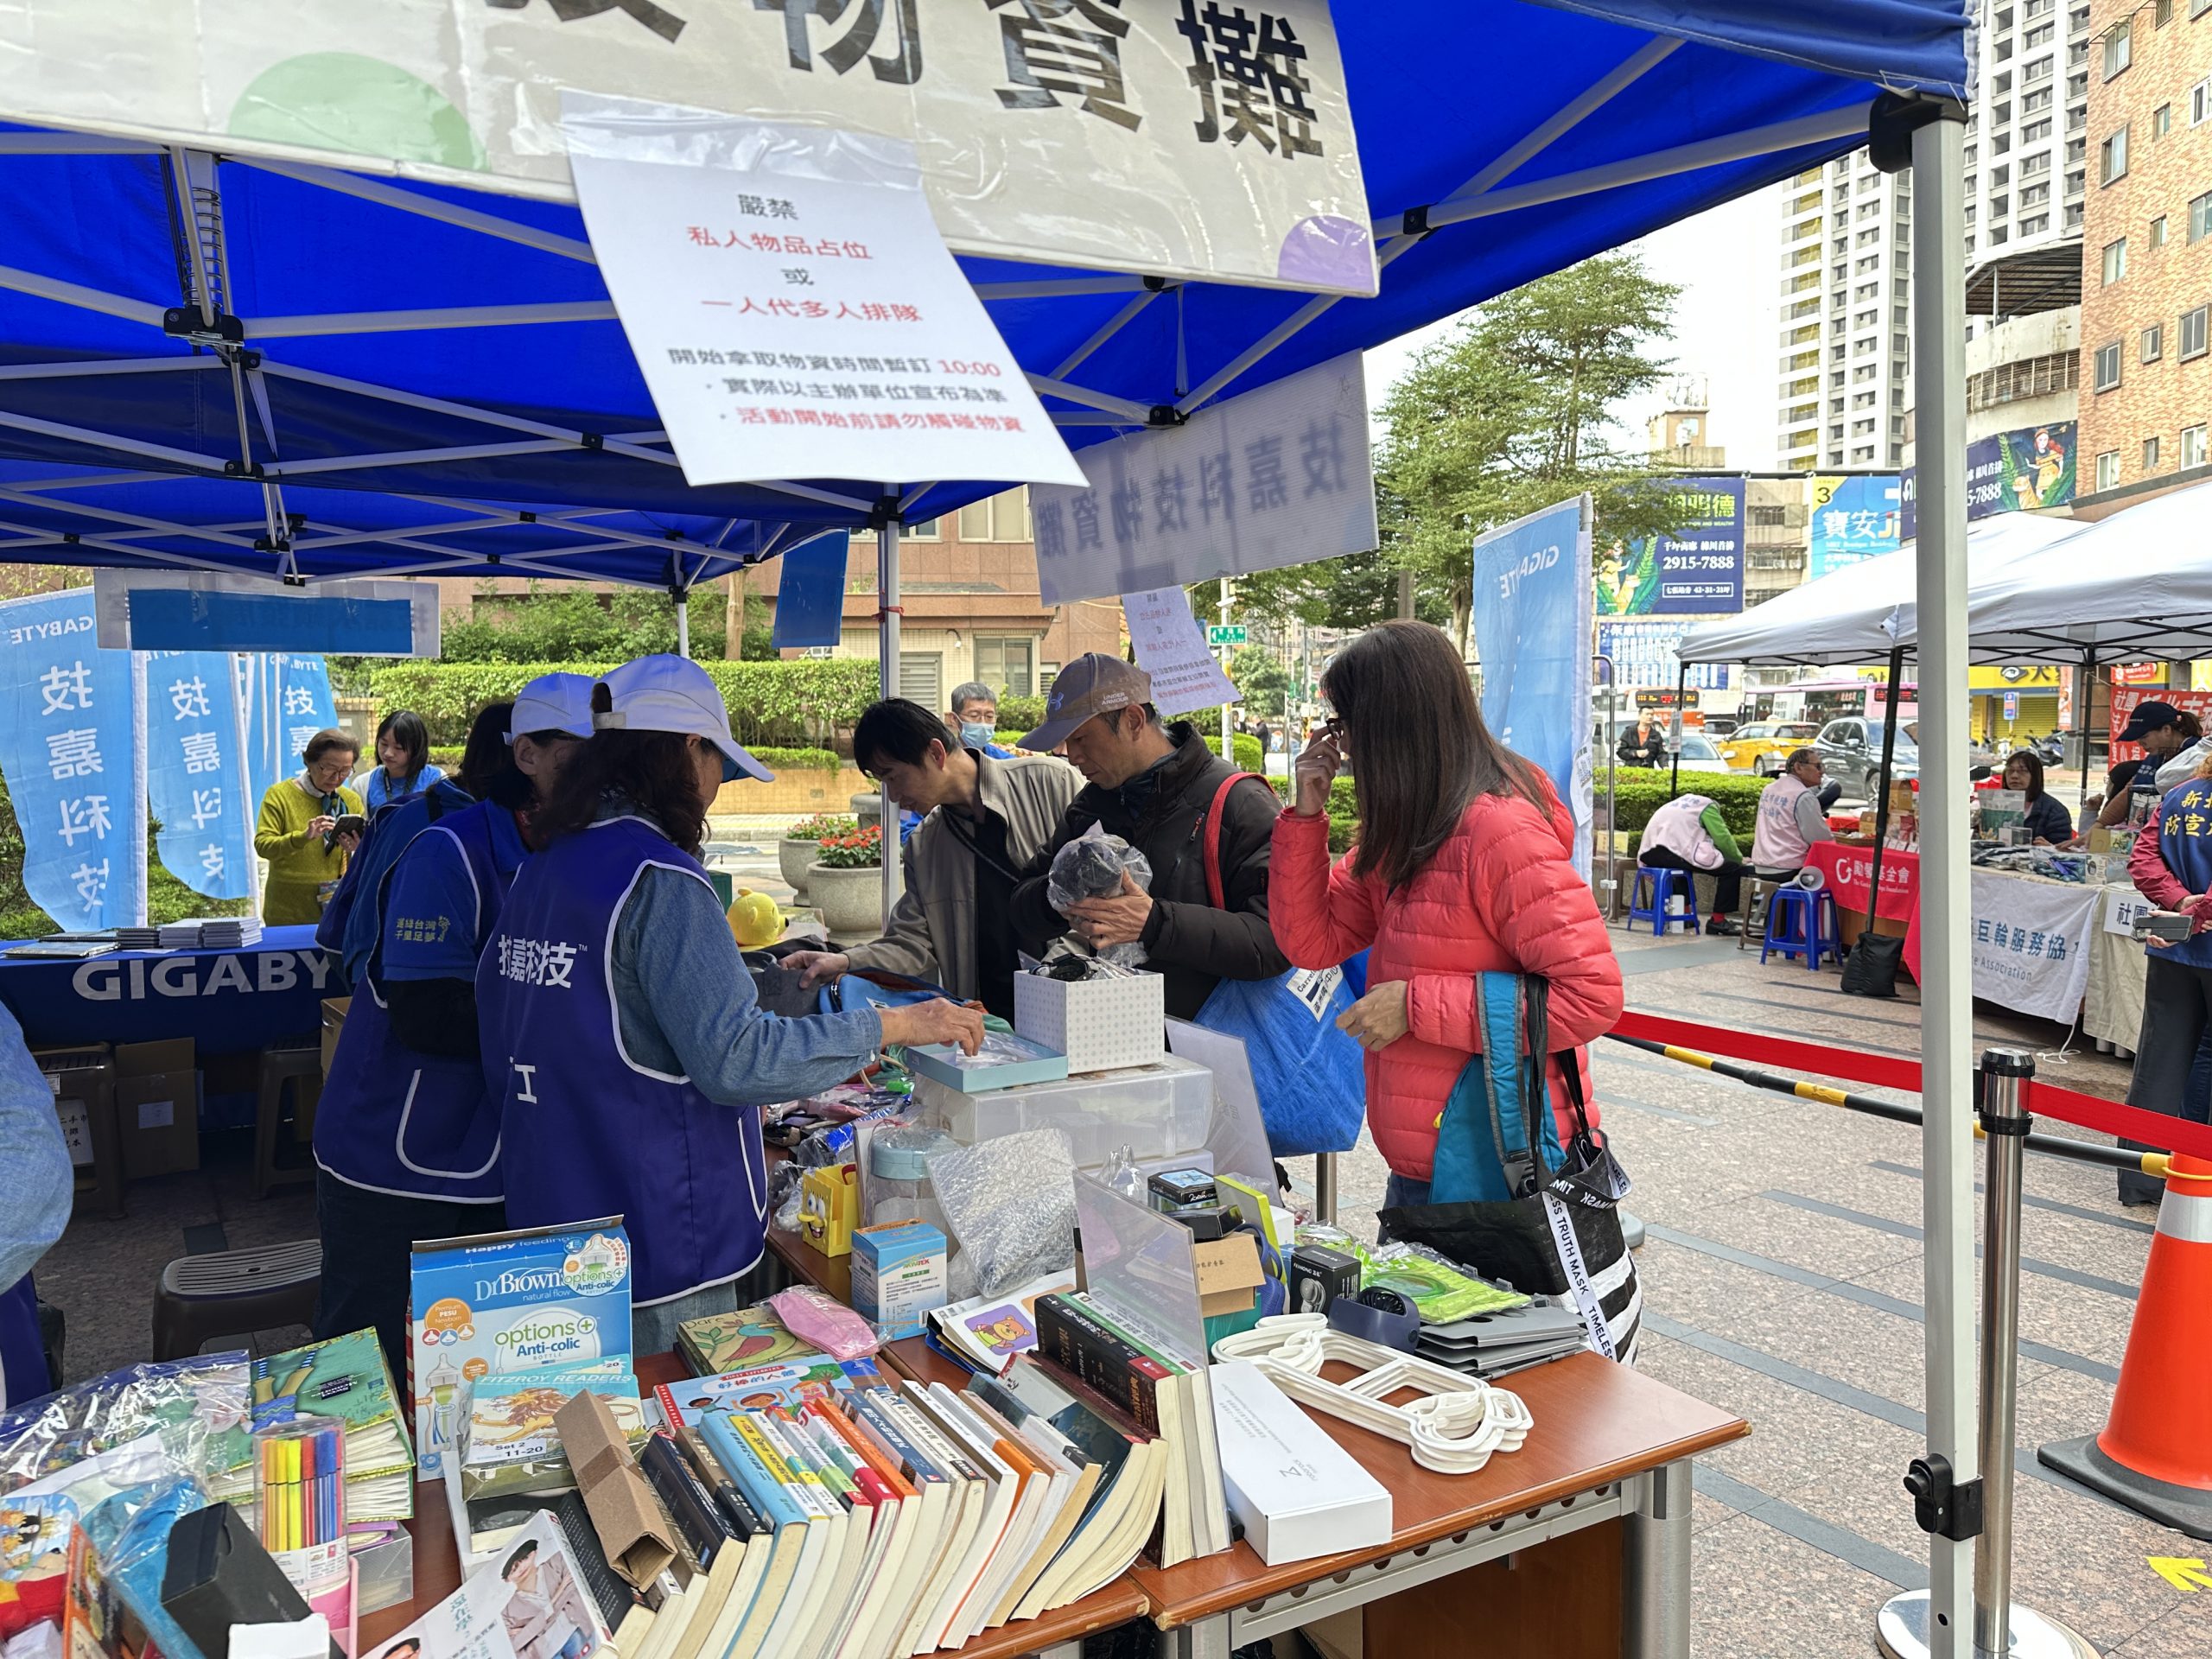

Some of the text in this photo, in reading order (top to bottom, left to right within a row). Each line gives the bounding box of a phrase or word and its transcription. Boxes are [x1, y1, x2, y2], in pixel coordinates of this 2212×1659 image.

[482, 0, 1324, 161] 物資攤
[738, 194, 799, 221] 嚴禁
[686, 226, 874, 260] 私人物品占位
[781, 268, 815, 287] 或
[701, 296, 924, 322] 一人代多人排隊
[667, 348, 1001, 378] 開始拿取物資時間暫訂 10:00
[721, 377, 1008, 404] 實際以主辦單位宣布為準
[735, 406, 1026, 434] 活動開始前請勿觸碰物資
[1816, 486, 1832, 505] 3
[1662, 555, 1735, 570] 2915-7888
[1102, 696, 1128, 705] ARMOUR
[2164, 813, 2212, 836] 防宣
[1971, 916, 2082, 962] 巨輪服務協
[73, 951, 332, 1001] GIGABY
[1980, 957, 2032, 982] Association
[465, 1243, 517, 1254] Happy
[1556, 1217, 1576, 1258] TRUTH
[1569, 1260, 1589, 1295] MASK
[563, 1268, 613, 1286] options
[576, 1280, 615, 1292] Anti-colic
[523, 1289, 571, 1302] natural flow
[435, 1303, 461, 1313] Premium
[435, 1315, 462, 1324] Newborn
[683, 1310, 756, 1331] Dare to
[494, 1320, 575, 1350] options
[517, 1338, 581, 1357] Anti-colic
[533, 1352, 563, 1361] BOTTLE
[481, 1374, 633, 1384] FITZROY READERS
[505, 1446, 543, 1458] 11-20
